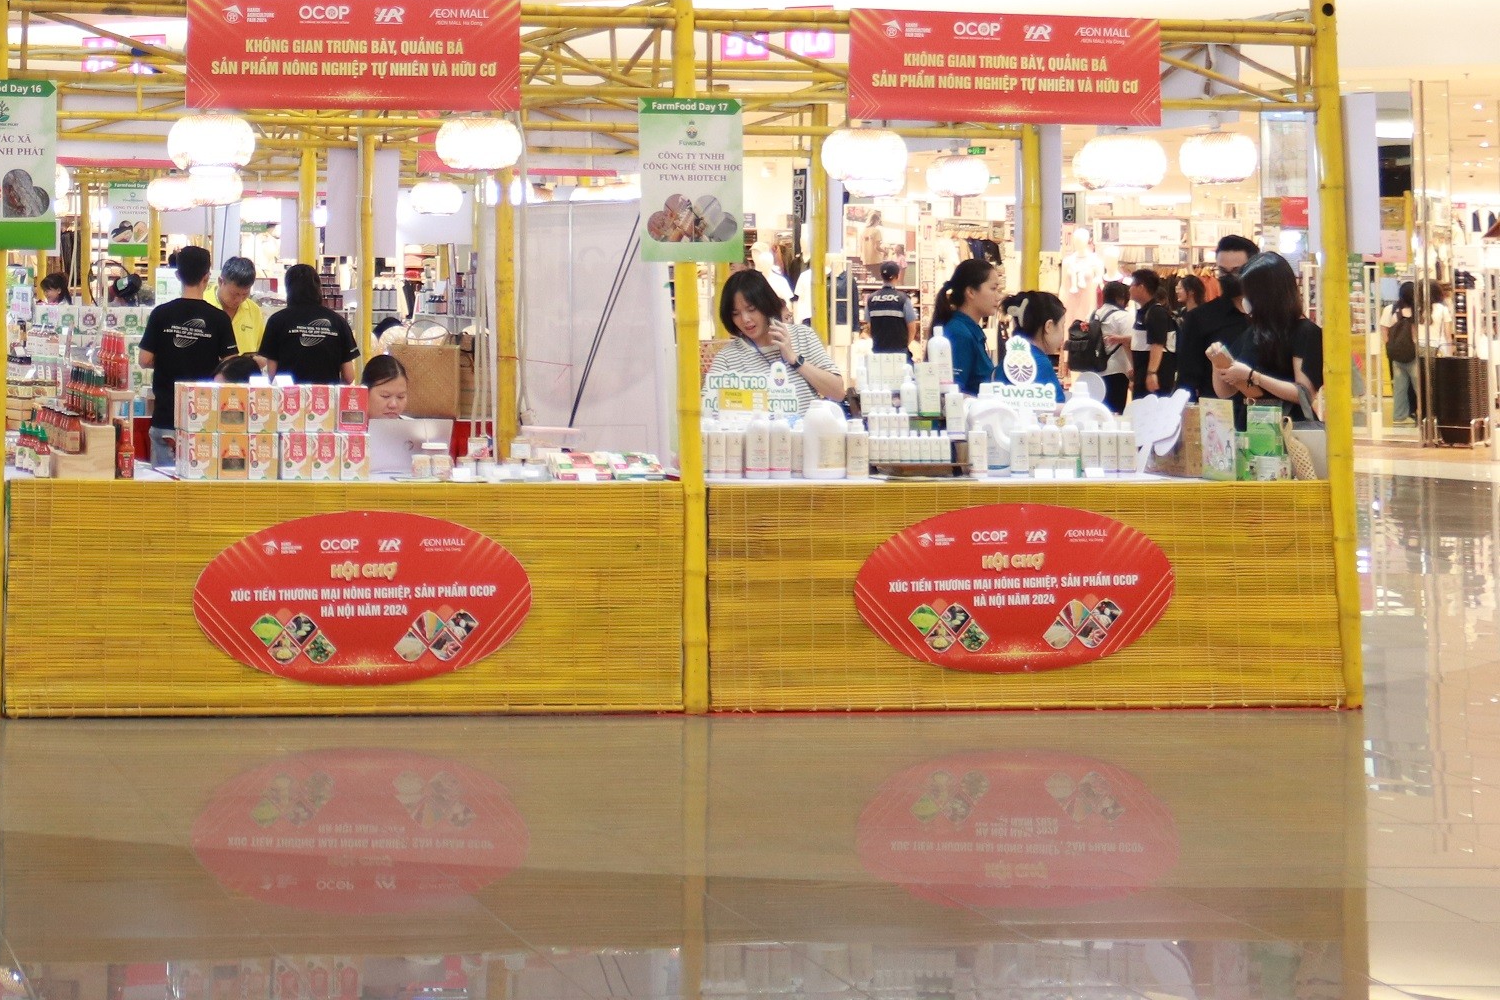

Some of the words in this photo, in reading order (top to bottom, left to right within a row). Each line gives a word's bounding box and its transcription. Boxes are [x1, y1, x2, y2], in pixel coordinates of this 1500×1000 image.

[299, 5, 349, 19] OCOP
[459, 8, 489, 18] MALL
[953, 21, 1000, 36] OCOP
[1102, 27, 1130, 37] MALL
[245, 37, 288, 53] KHÔNG
[292, 39, 323, 53] GIAN
[326, 38, 367, 53] TRƯNG
[371, 37, 397, 55] BÀY,
[400, 37, 443, 55] QUẢNG
[446, 38, 463, 54] BÁ
[211, 58, 237, 74] SẢN
[241, 58, 278, 75] PHẨM
[282, 58, 317, 75] NÔNG
[321, 59, 367, 78] NGHIỆP
[370, 61, 388, 79] TỰ
[389, 59, 428, 76] NHIÊN
[431, 60, 448, 76] VÀ
[451, 60, 476, 76] HỮU
[479, 61, 497, 76] CƠ
[903, 51, 944, 67] KHÔNG
[947, 54, 976, 68] GIAN
[978, 54, 1017, 69] TRƯNG
[1020, 54, 1045, 71] BÀY,
[1048, 53, 1088, 72] QUẢNG
[1091, 55, 1107, 71] BÁ
[10, 84, 28, 95] Day
[30, 84, 41, 93] 16
[871, 72, 897, 87] SẢN
[900, 72, 935, 88] PHẨM
[938, 73, 971, 89] NÔNG
[974, 74, 1018, 93] NGHIỆP
[1020, 76, 1036, 93] TỰ
[1038, 75, 1074, 92] NHIÊN
[1077, 76, 1092, 92] VÀ
[1095, 77, 1119, 93] HỮU
[1122, 79, 1138, 94] CƠ
[651, 101, 696, 110] FarmFood
[698, 102, 716, 113] Day
[717, 103, 728, 111] 17
[17, 133, 31, 143] XÃ
[657, 151, 683, 159] CÔNG
[698, 152, 724, 160] TNHH
[642, 161, 668, 170] CÔNG
[671, 162, 695, 170] NGHỆ
[723, 163, 741, 172] HỌC
[871, 294, 900, 302] ALSOK
[709, 373, 741, 389] KIẾN
[991, 385, 1054, 400] Fuwa3e
[971, 530, 1007, 542] OCOP
[320, 538, 359, 550] OCOP
[981, 551, 1009, 571] HỘI
[1010, 552, 1044, 570] CHỢ
[330, 560, 359, 580] HỘI
[361, 561, 397, 579] CHỢ
[888, 579, 908, 592] XÚC
[910, 577, 932, 591] TIẾN
[933, 578, 971, 591] THƯƠNG
[973, 578, 992, 591] MẠI
[993, 575, 1020, 589] NÔNG
[1022, 574, 1058, 590] NGHIỆP,
[1060, 573, 1080, 587] SẢN
[1082, 572, 1111, 586] PHẨM
[1112, 574, 1138, 585] OCOP
[230, 588, 250, 601] XÚC
[253, 586, 276, 601] TIẾN
[278, 587, 318, 600] THƯƠNG
[320, 588, 340, 602] MẠI
[342, 585, 371, 599] NÔNG
[373, 584, 411, 600] NGHIỆP,
[414, 584, 435, 598] SẢN
[437, 583, 467, 597] PHẨM
[469, 585, 496, 597] OCOP
[973, 593, 987, 606] HÀ
[988, 592, 1005, 607] NỘI
[1007, 592, 1030, 605] NĂM
[1031, 593, 1055, 604] 2024
[320, 603, 334, 617] HÀ
[336, 603, 354, 618] NỘI
[357, 602, 381, 616] NĂM
[383, 604, 407, 615] 2024
